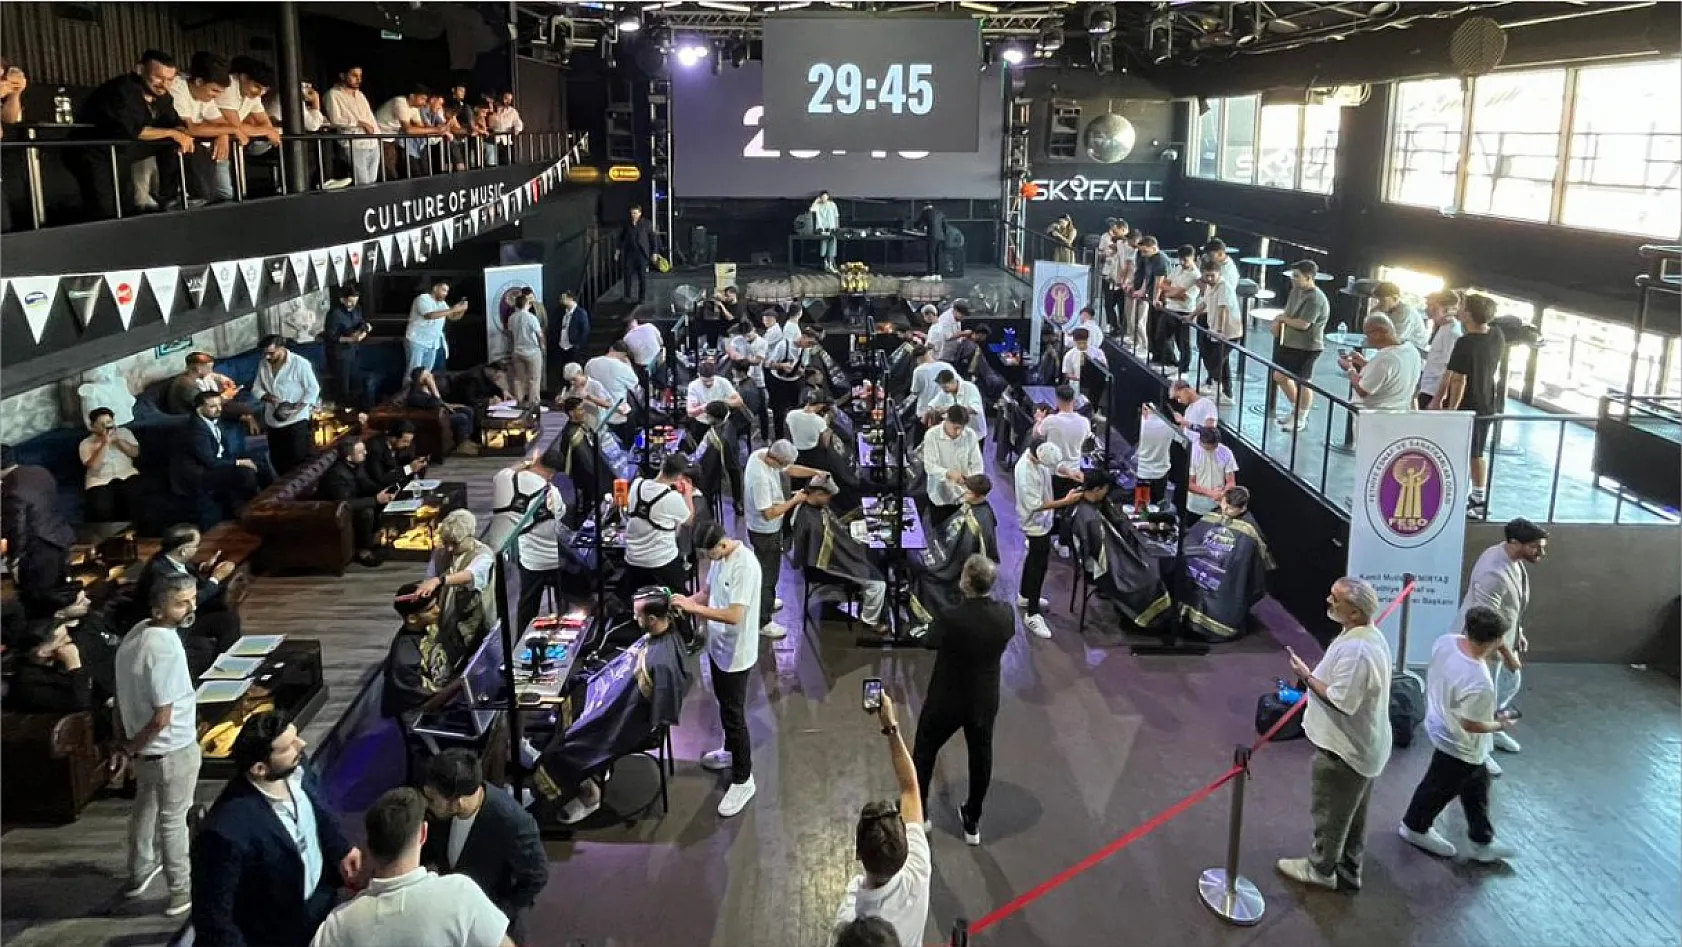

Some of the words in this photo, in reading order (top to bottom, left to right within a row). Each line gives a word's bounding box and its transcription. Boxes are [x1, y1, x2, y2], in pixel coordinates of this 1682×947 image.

[807, 62, 934, 115] 29:45
[363, 194, 444, 233] CULTURE
[449, 189, 467, 212] OF
[470, 181, 506, 207] MUSIC
[1031, 175, 1164, 201] SKYFALL
